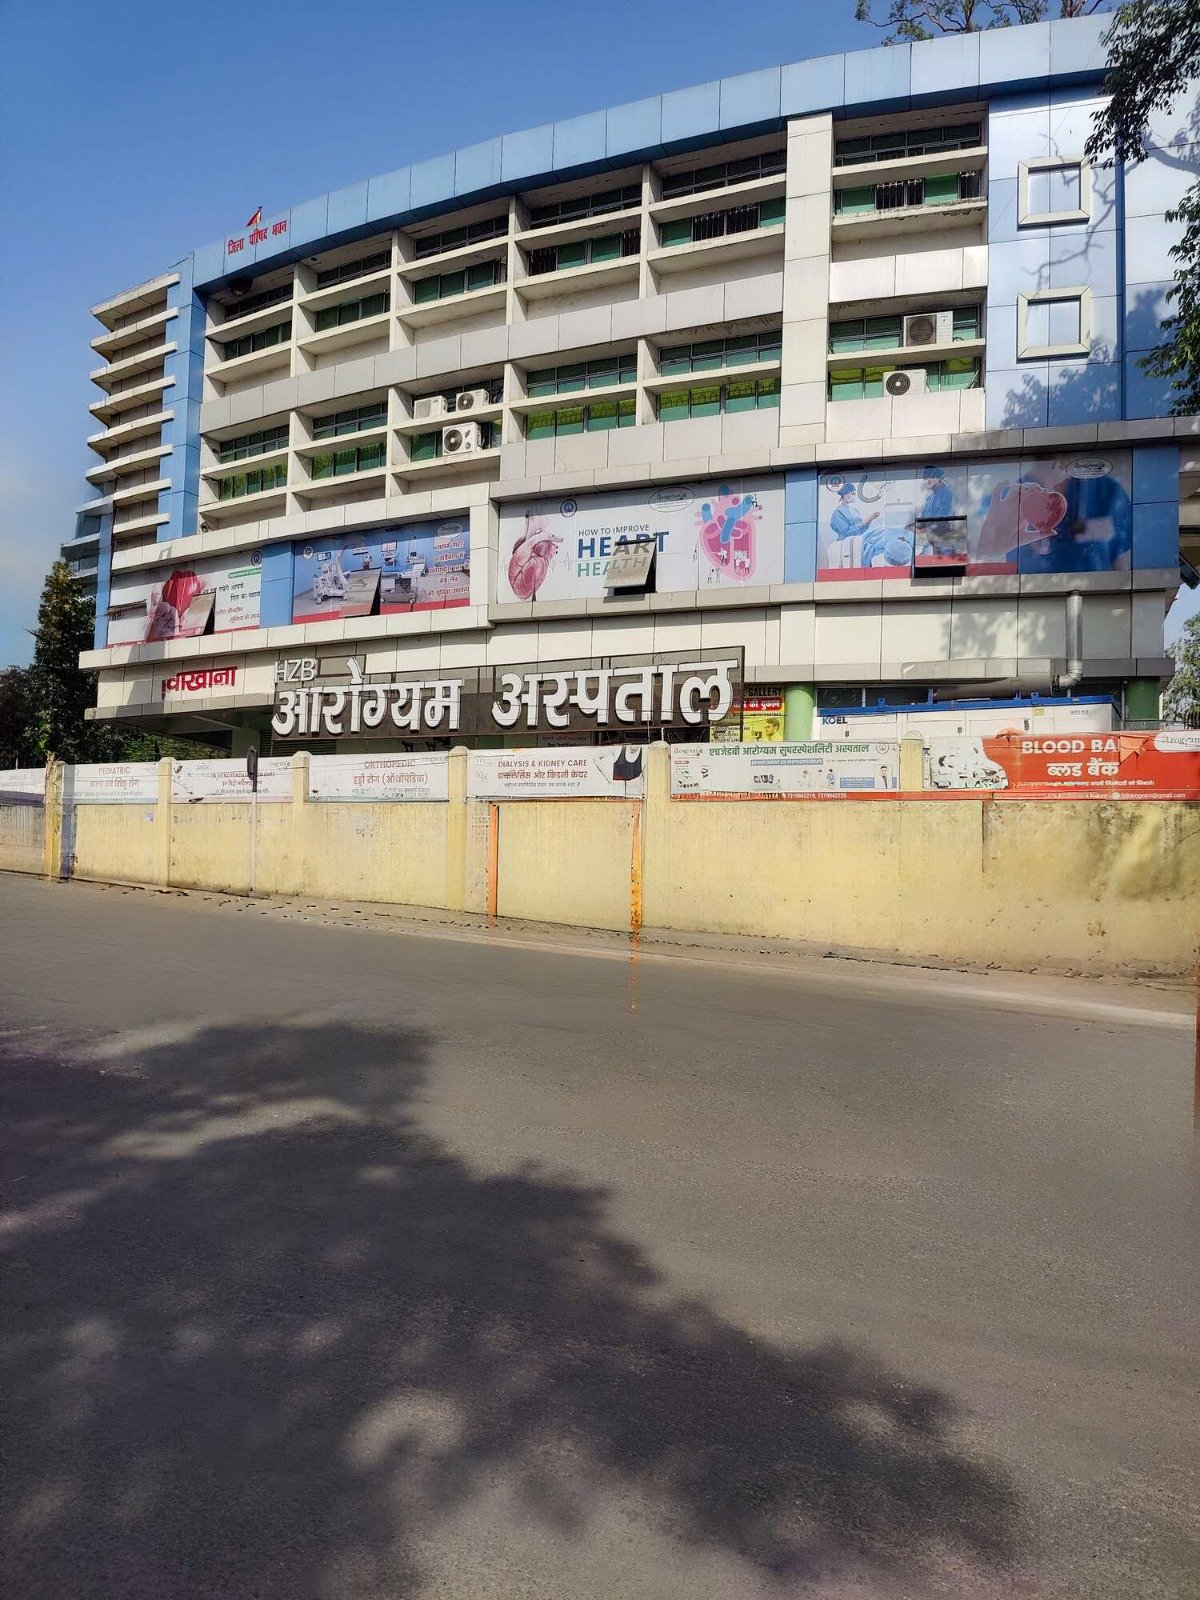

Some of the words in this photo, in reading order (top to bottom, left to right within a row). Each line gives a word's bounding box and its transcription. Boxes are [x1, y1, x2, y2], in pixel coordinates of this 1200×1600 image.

[228, 238, 244, 255] जिला
[249, 228, 268, 245] परिषद
[272, 220, 287, 236] भवन
[578, 528, 599, 537] HOW
[601, 527, 611, 535] TO
[613, 524, 650, 533] IMPROVE
[577, 531, 670, 559] HEART
[577, 557, 648, 578] HEALTH
[274, 657, 318, 683] HZB
[271, 656, 464, 735] आरोग्यम
[491, 659, 739, 727] अस्पताल
[748, 687, 782, 697] GALLERY
[822, 715, 848, 725] KOEL
[709, 744, 740, 756] एचजेडबी
[742, 745, 776, 756] आरोग्यम
[779, 742, 833, 757] सुपरस्पेशलिटी
[835, 743, 869, 754] अस्पताल
[1022, 739, 1086, 755] BLOOD
[1091, 738, 1120, 754] BA
[364, 759, 416, 769] ORTHOPEDIC
[497, 758, 530, 768] DIALYSIS
[531, 759, 537, 767] &
[538, 759, 565, 768] KIDNEY
[567, 759, 588, 767] CARE
[1046, 762, 1083, 777] ब्लड
[1086, 757, 1120, 777] बैंक
[98, 765, 131, 776] PEDIATRIC
[547, 769, 569, 779] किडनी
[570, 770, 588, 779] केयर
[367, 772, 380, 785] रोग
